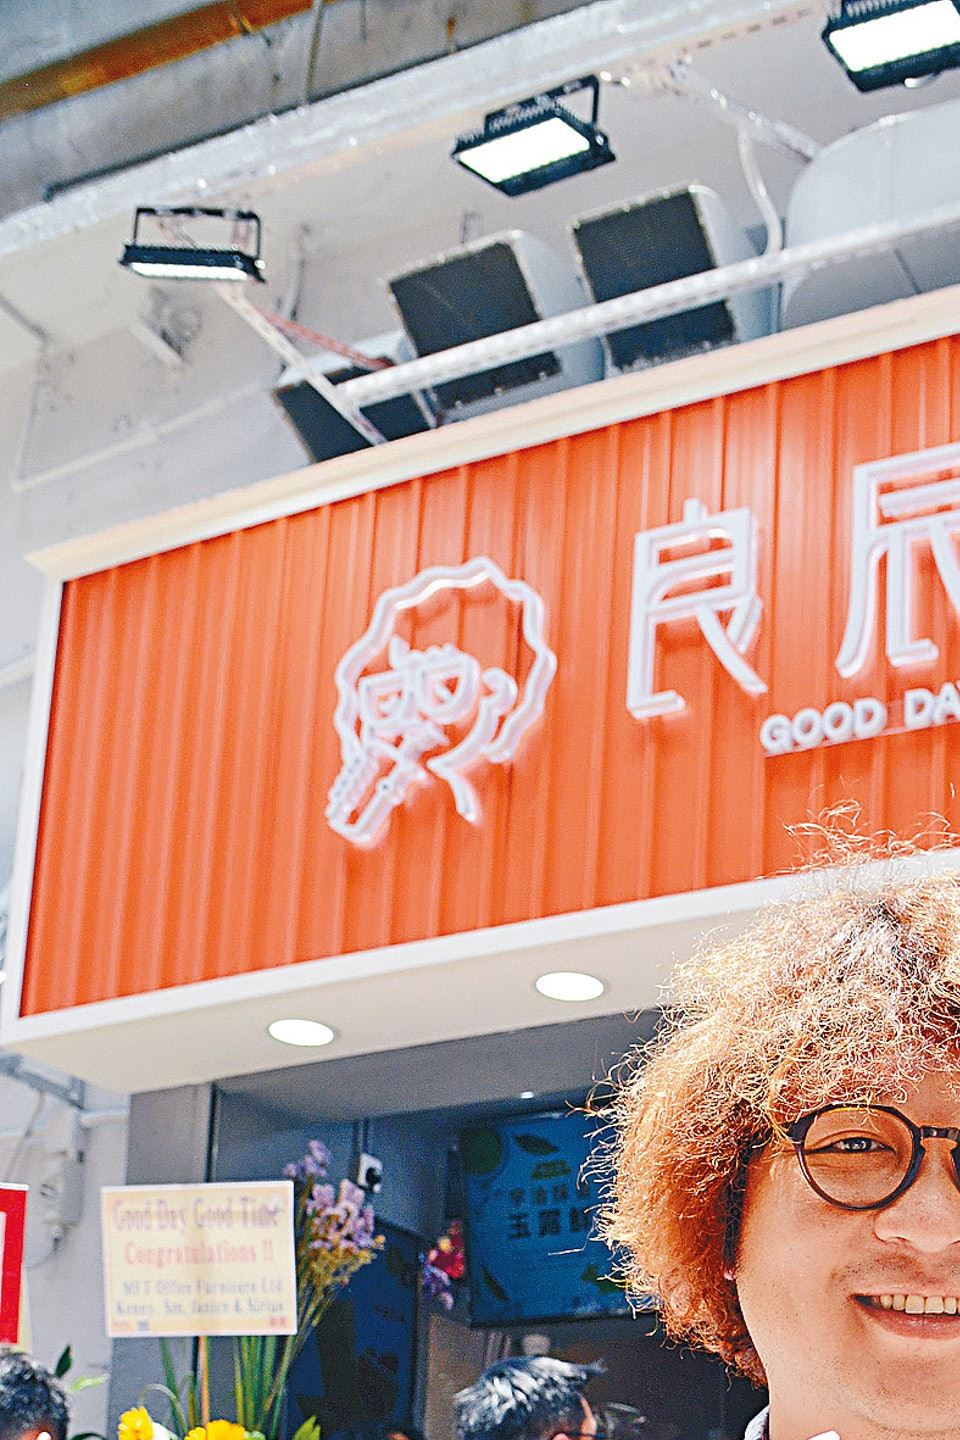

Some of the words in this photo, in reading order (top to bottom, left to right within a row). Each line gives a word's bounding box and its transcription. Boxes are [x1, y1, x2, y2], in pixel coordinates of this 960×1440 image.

[759, 696, 888, 754] GOOD
[112, 1199, 152, 1231] Good
[192, 1197, 234, 1229] Good
[124, 1240, 257, 1269] Congratulations
